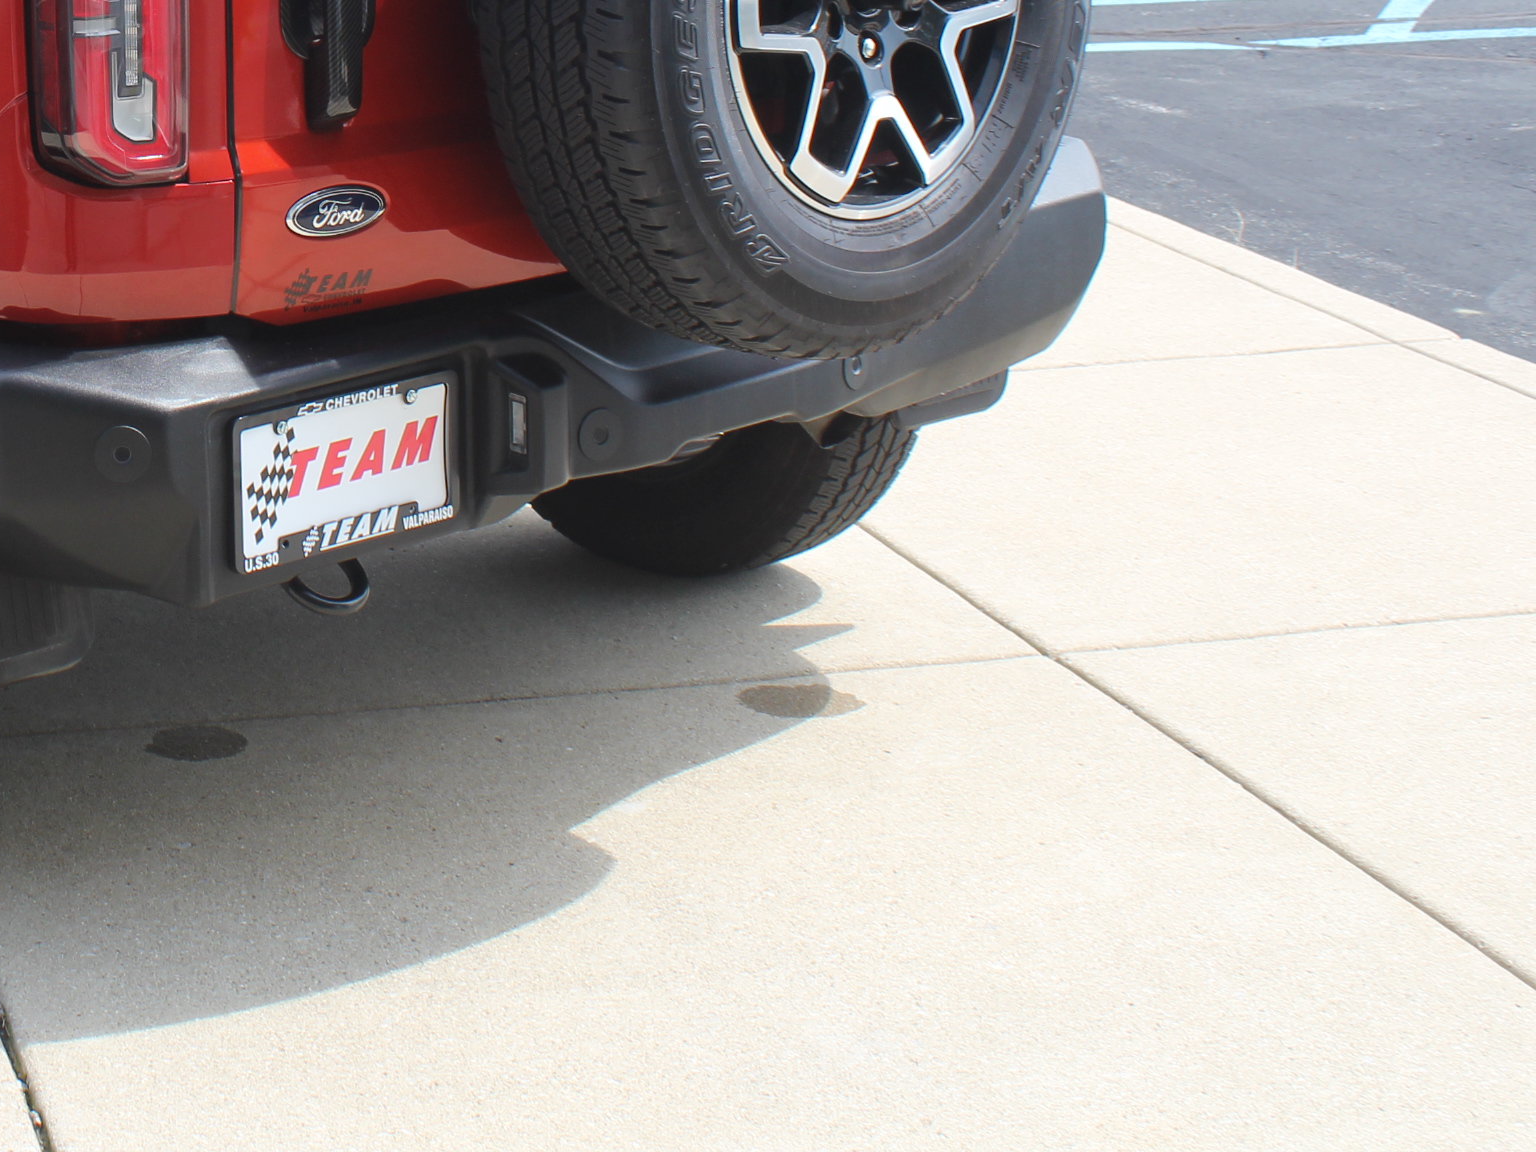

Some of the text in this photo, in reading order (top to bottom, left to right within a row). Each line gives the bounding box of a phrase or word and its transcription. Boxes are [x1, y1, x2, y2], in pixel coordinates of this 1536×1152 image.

[313, 197, 365, 229] Ford
[325, 384, 399, 411] CHEVROLET
[288, 415, 439, 498] TEAM
[321, 505, 399, 549] TEAM
[402, 505, 454, 531] VALPARAISO
